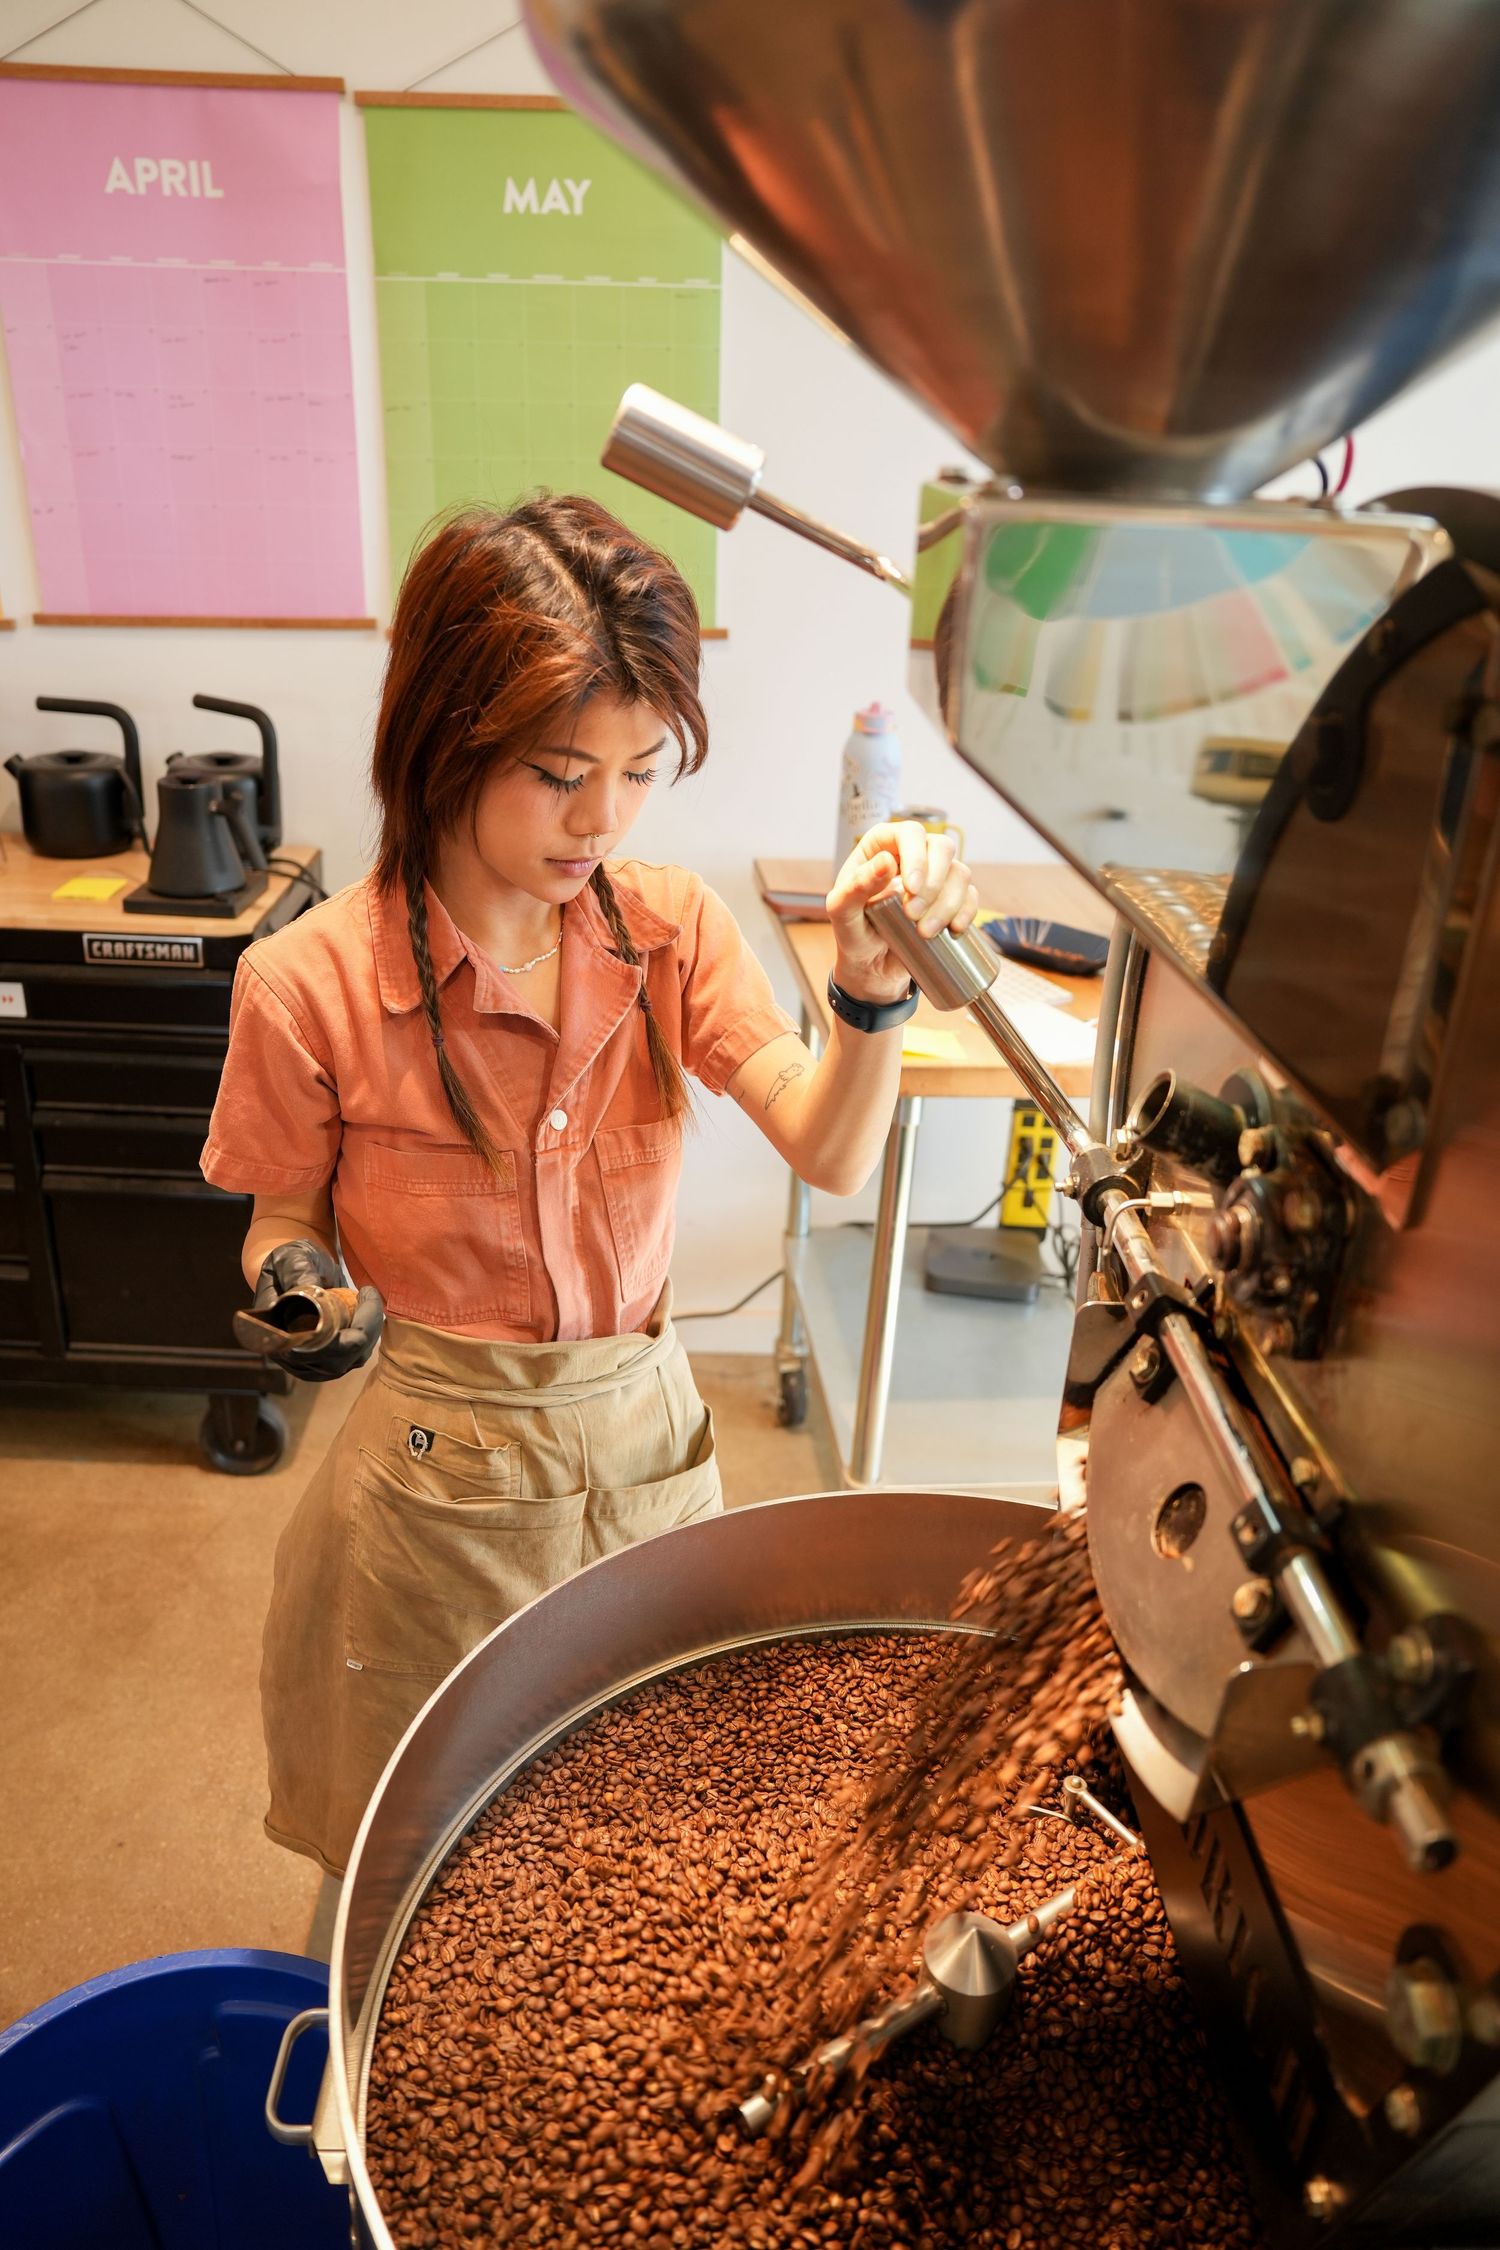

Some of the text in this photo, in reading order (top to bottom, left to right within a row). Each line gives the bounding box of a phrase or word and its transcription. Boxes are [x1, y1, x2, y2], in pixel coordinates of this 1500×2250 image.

[104, 155, 224, 199] APRIL
[502, 175, 593, 216] MAY
[91, 940, 195, 961] CRAFTSMAN
